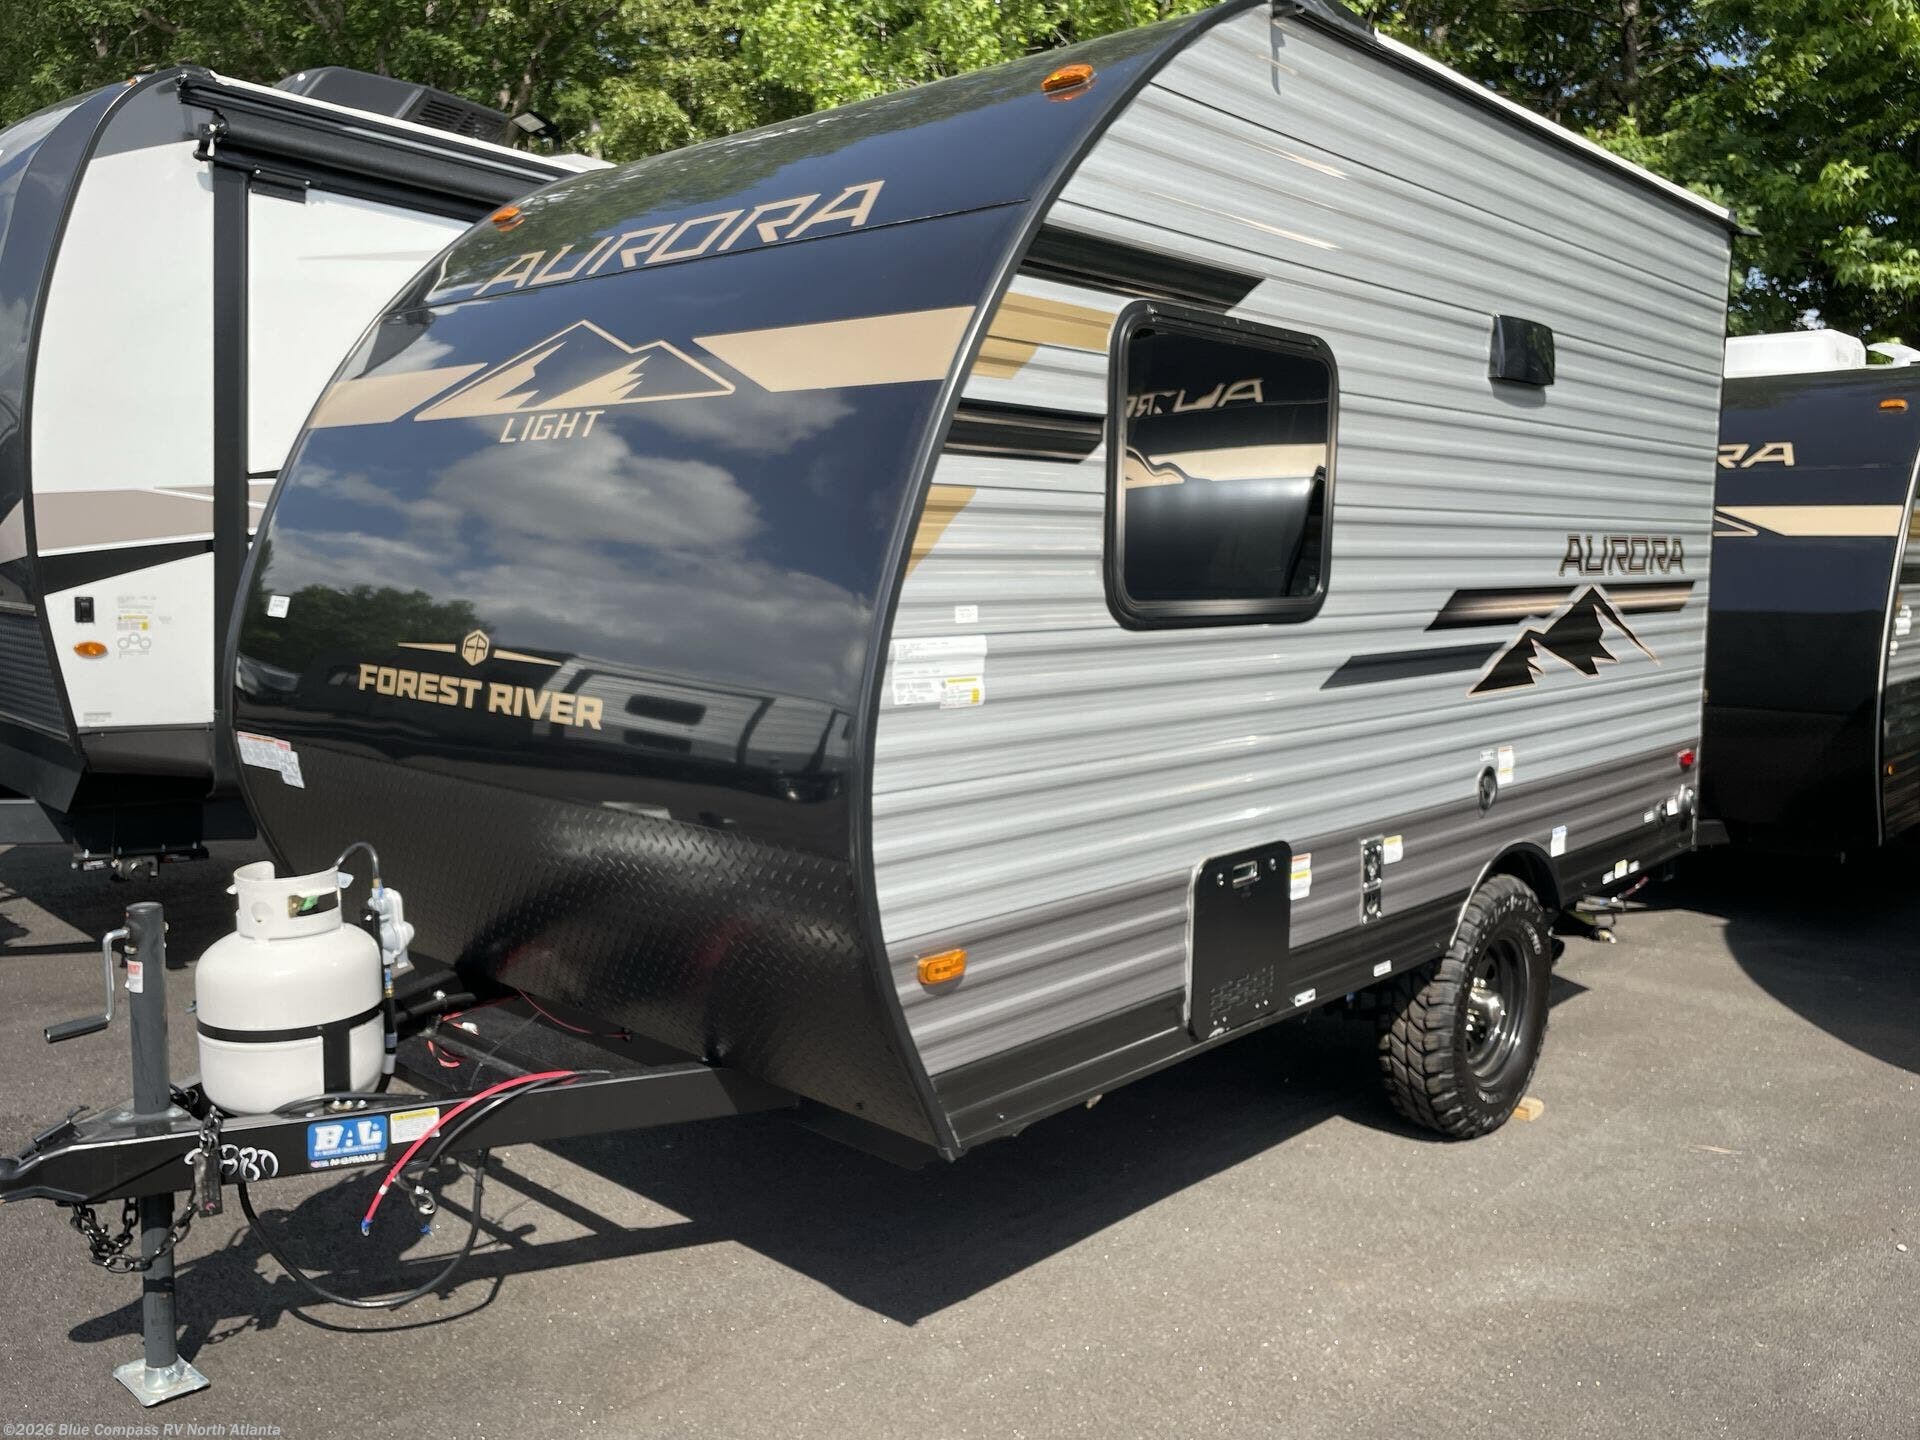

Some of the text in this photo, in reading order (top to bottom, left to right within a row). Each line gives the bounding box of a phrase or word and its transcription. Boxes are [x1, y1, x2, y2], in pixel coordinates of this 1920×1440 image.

[472, 180, 885, 297] AURORA
[500, 409, 605, 443] LIGHT
[1558, 534, 1686, 577] AURORA
[358, 663, 604, 731] FOREST RIVER
